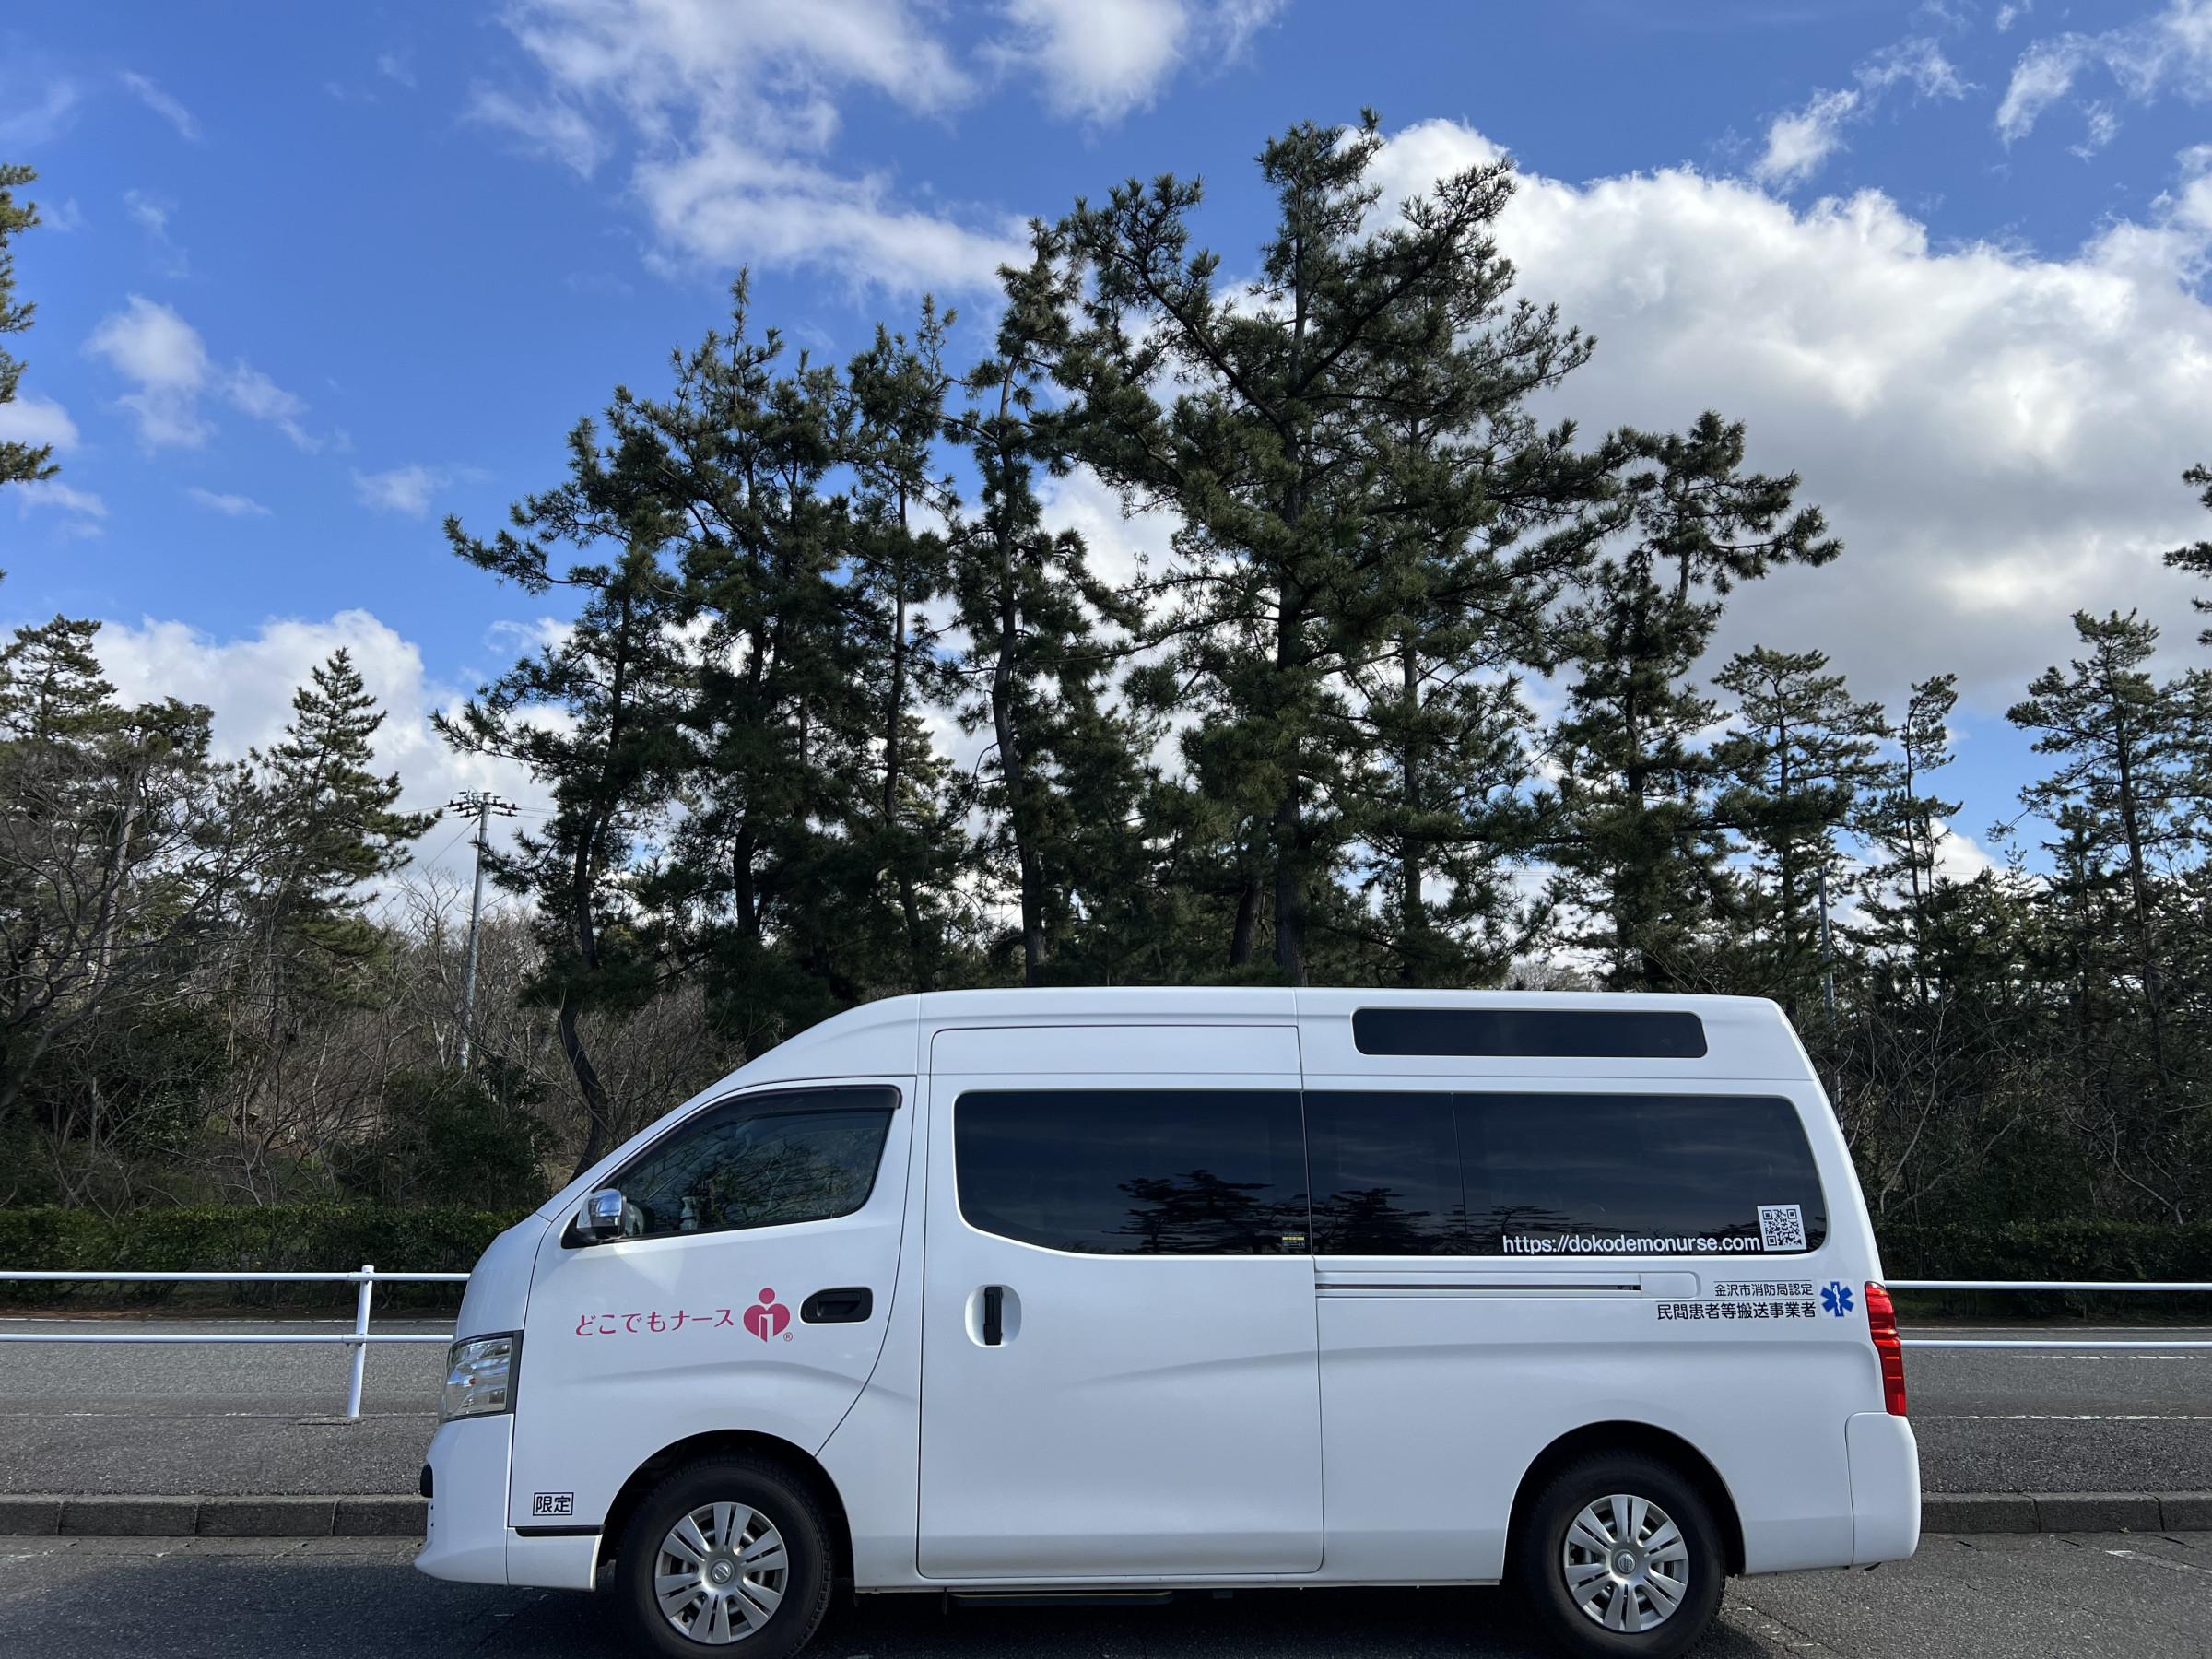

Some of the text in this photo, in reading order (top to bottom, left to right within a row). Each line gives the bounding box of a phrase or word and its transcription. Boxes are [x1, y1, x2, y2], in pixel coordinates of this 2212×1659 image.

[1502, 1234, 1760, 1254] https://dokodemonurse.com
[1714, 1283, 1814, 1297] 金沢市消防局認定
[1657, 1301, 1816, 1321] 民間患者等搬送事業者
[575, 1310, 735, 1336] どこでもナース
[535, 1495, 571, 1513] 限定
